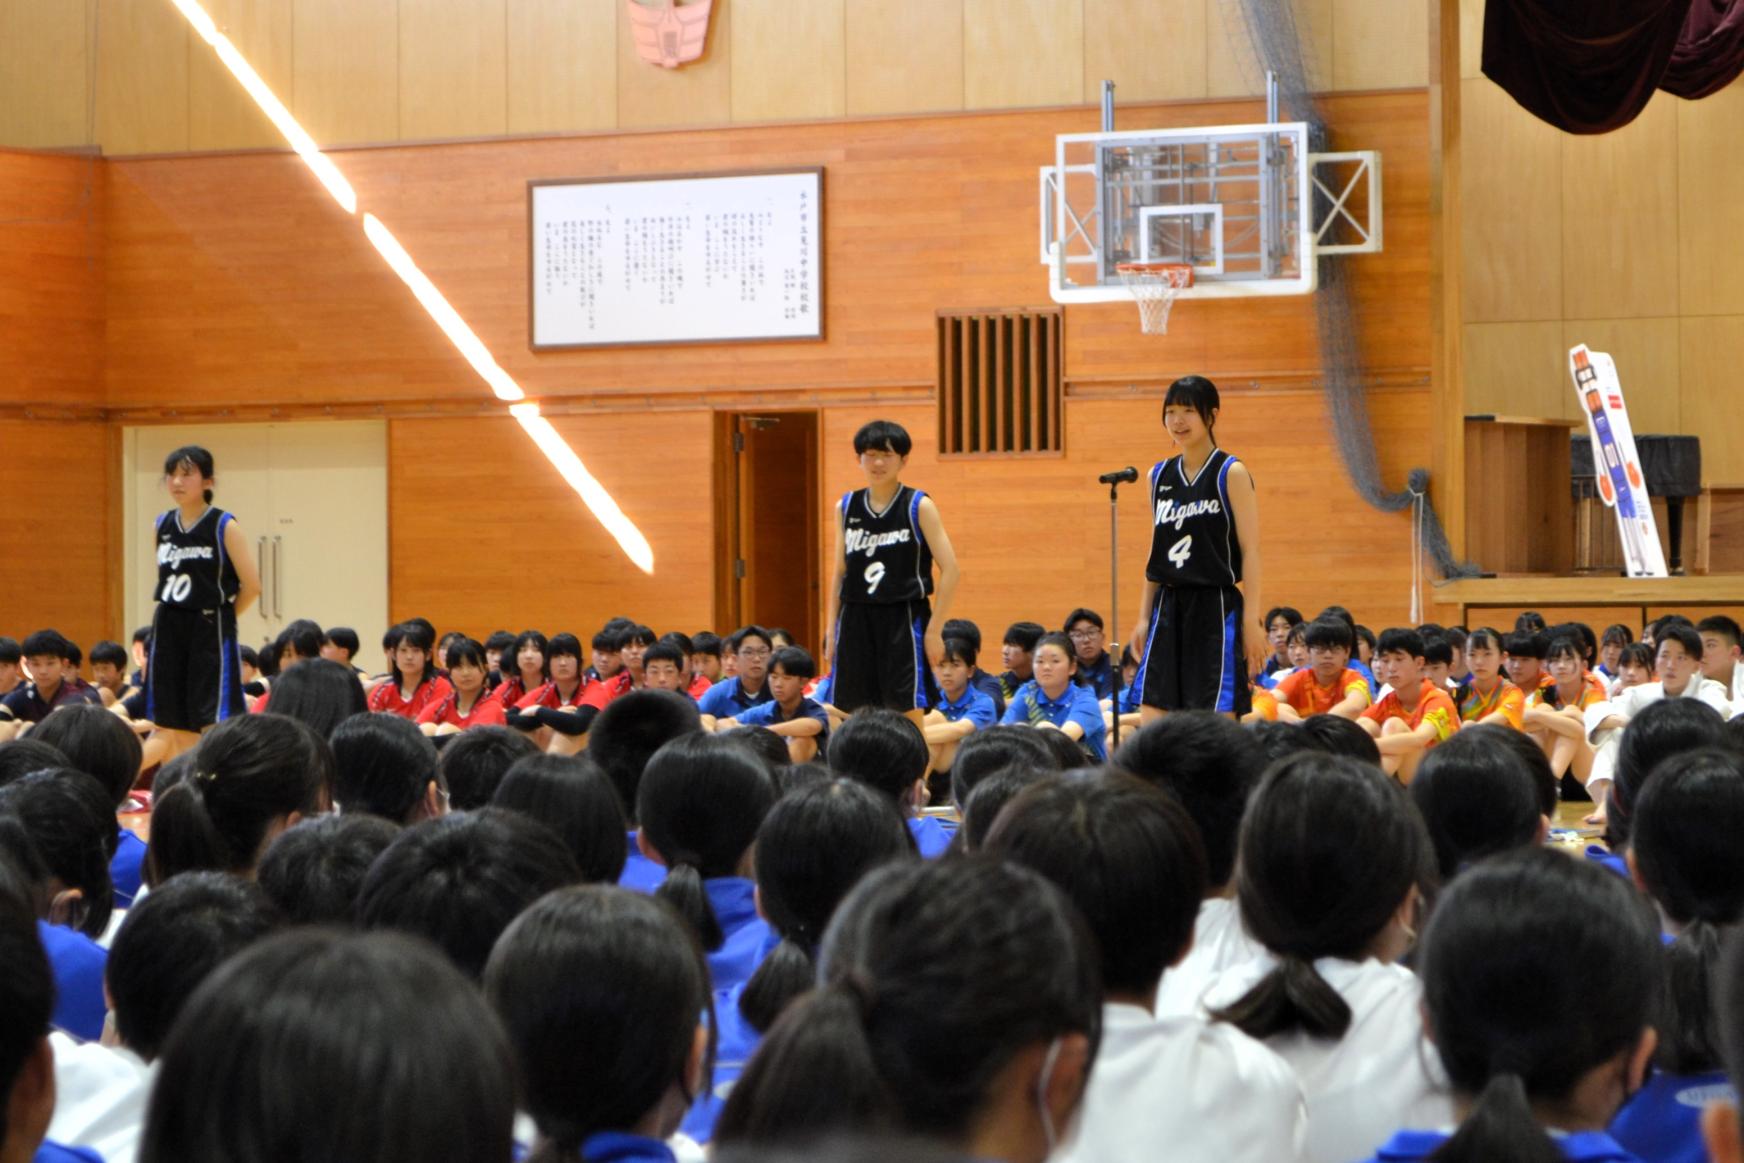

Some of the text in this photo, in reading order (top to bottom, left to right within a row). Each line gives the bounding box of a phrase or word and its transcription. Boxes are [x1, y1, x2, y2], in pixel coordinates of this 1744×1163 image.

[846, 527, 911, 558] Migawa
[1168, 534, 1193, 569] 4
[161, 573, 192, 603] 10
[864, 561, 885, 595] 9
